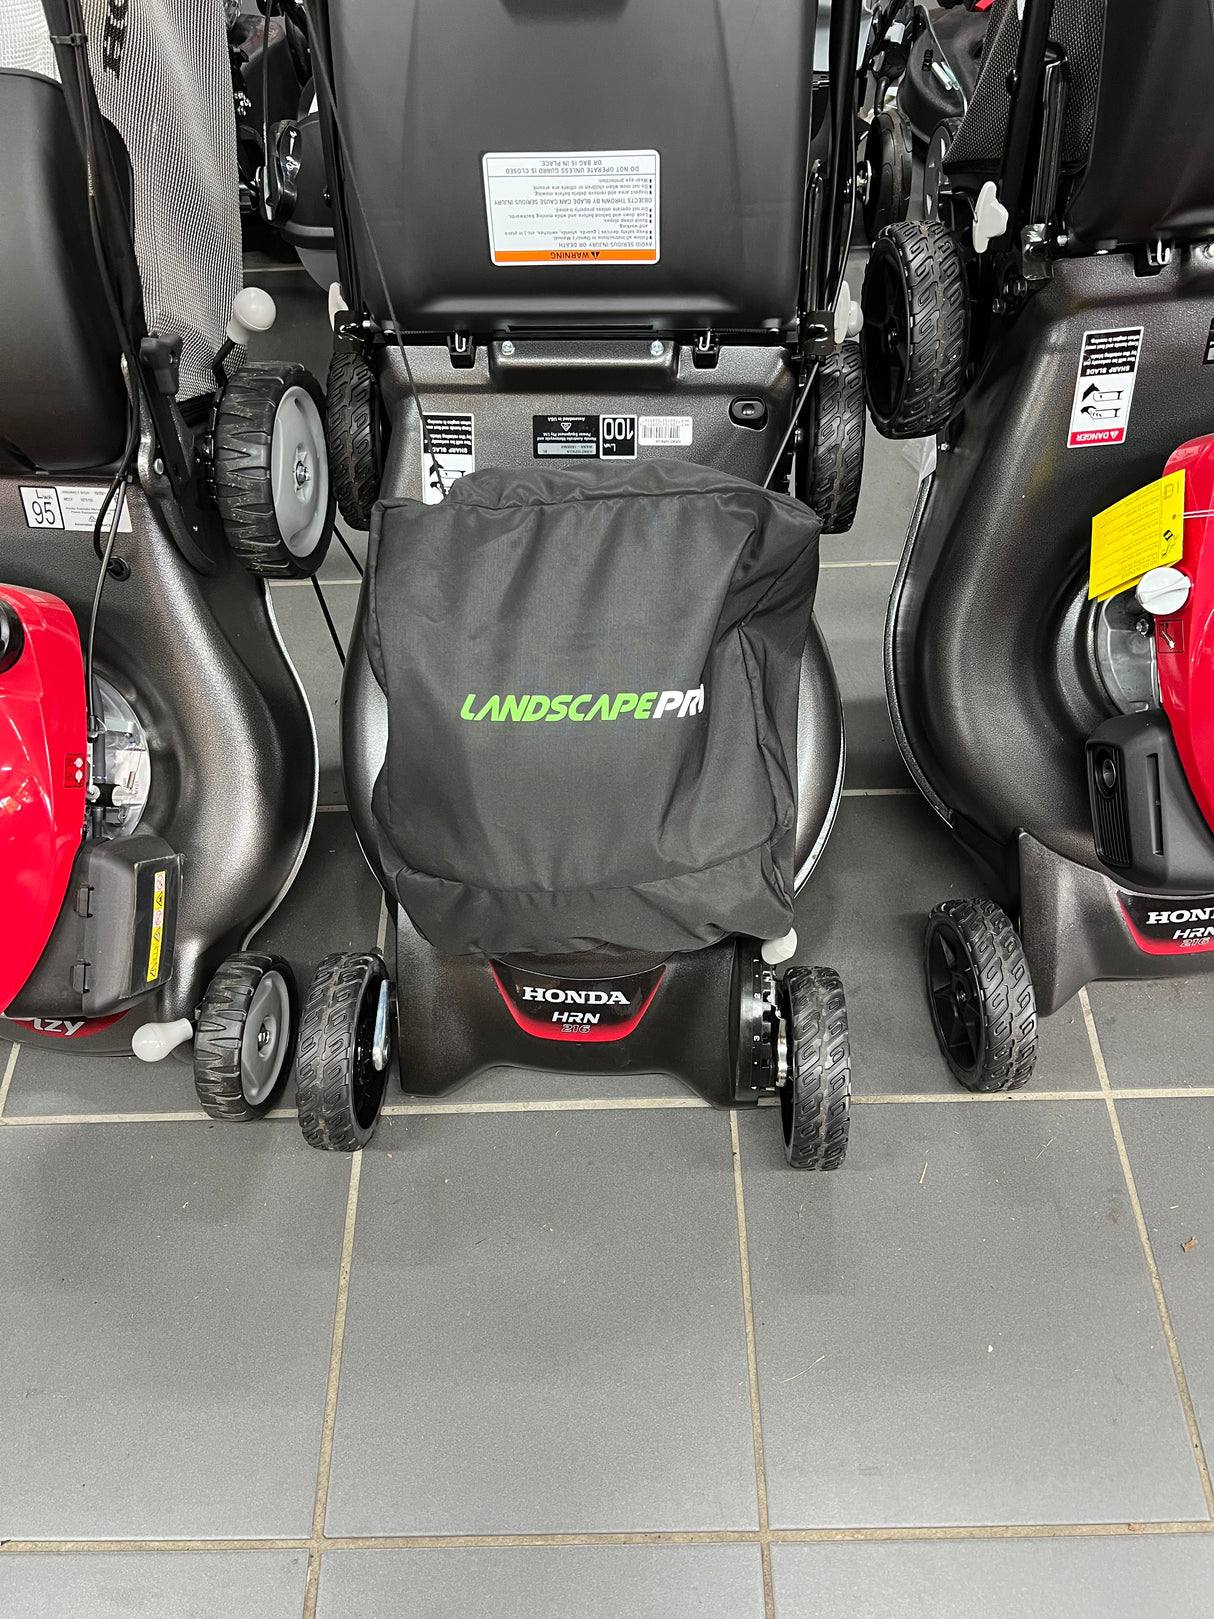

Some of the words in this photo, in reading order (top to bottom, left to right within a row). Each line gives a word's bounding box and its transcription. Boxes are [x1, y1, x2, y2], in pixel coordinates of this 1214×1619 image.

[604, 418, 634, 440] 100
[1076, 432, 1109, 441] DANGER
[32, 501, 55, 525] 95
[1146, 907, 1214, 924] HON
[1180, 937, 1210, 947] 216
[522, 986, 630, 1005] HONDA
[552, 1012, 600, 1024] HRN
[561, 1024, 591, 1034] 216
